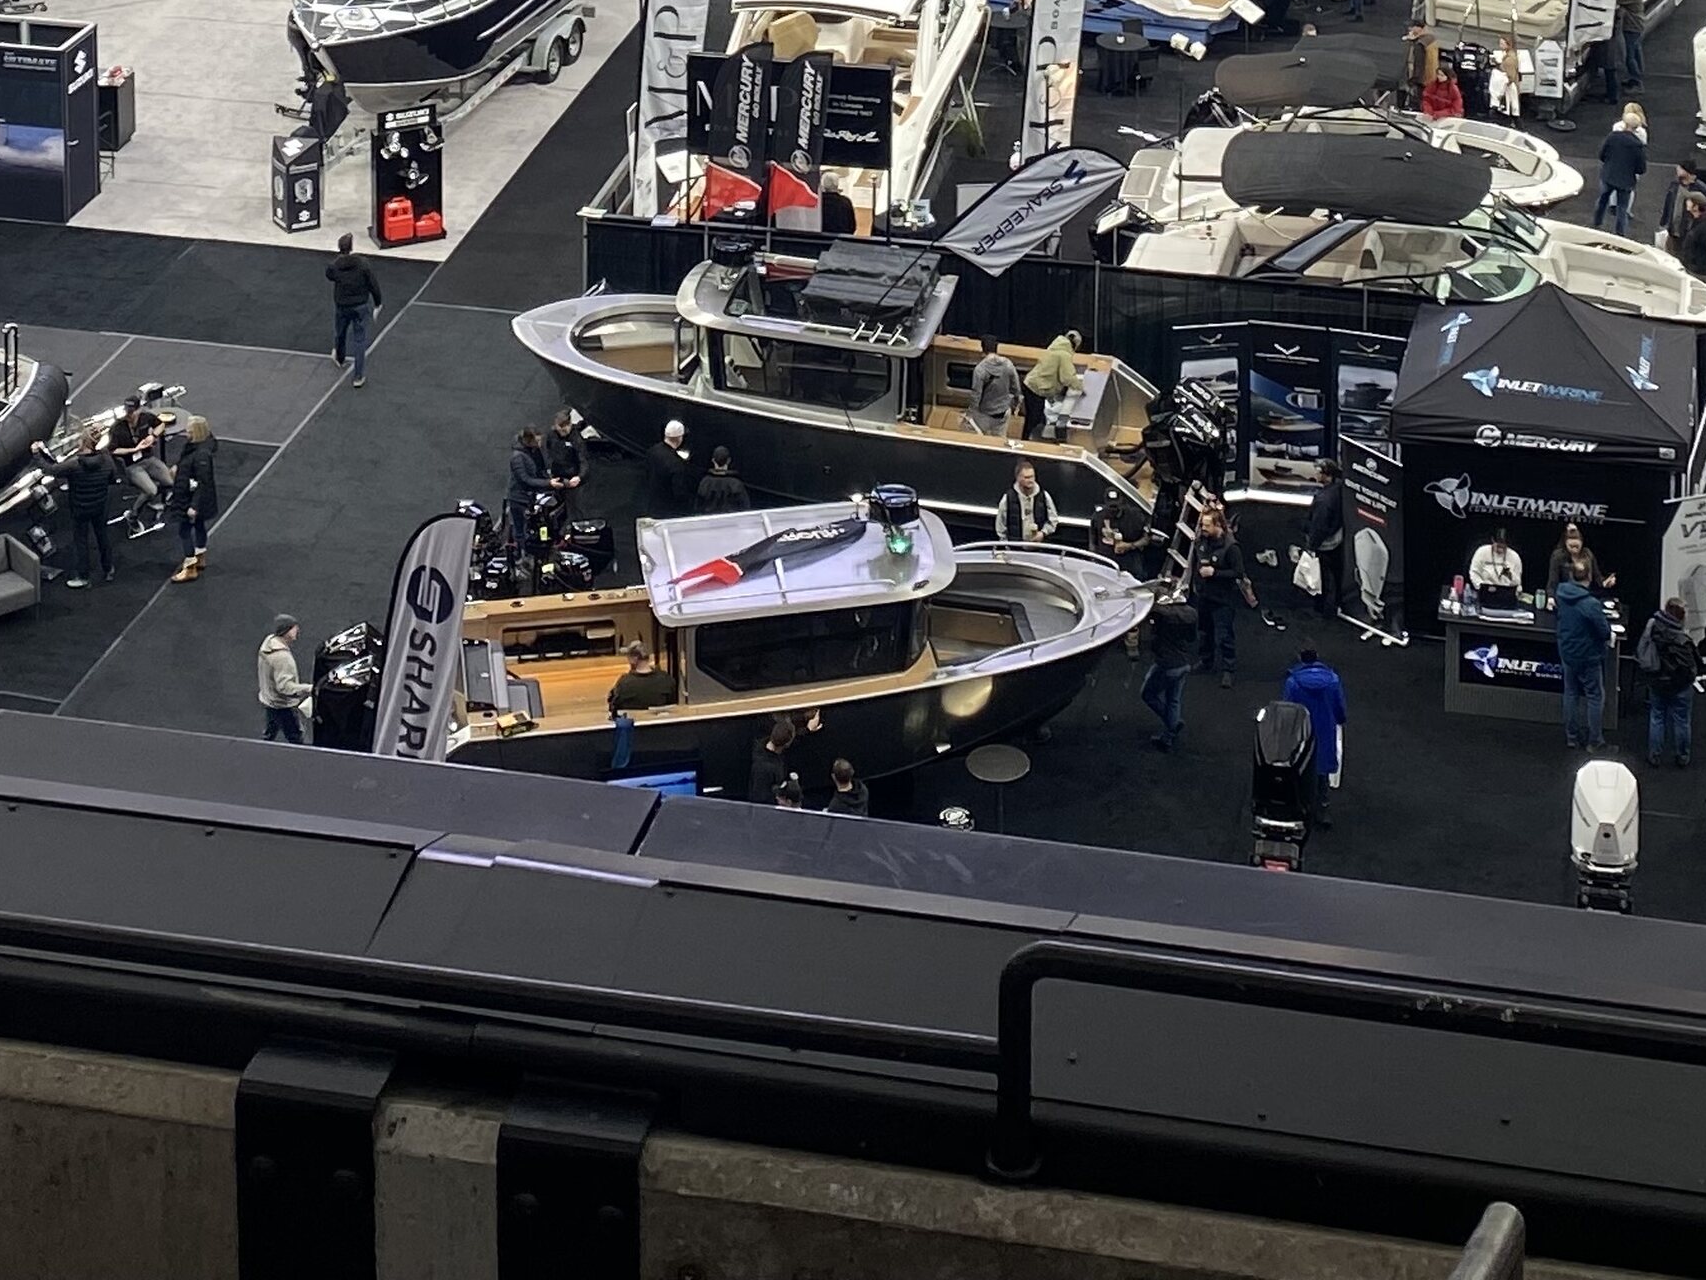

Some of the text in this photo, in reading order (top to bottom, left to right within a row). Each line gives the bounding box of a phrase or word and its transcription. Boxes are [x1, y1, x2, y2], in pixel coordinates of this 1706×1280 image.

[644, 5, 697, 130] M&P
[754, 65, 764, 103] BOLDLY
[736, 54, 757, 144] MERCURY
[797, 60, 817, 150] MERCURY
[969, 176, 1064, 259] SEAKEEPER
[1496, 377, 1605, 403] INLETMARINE
[1502, 432, 1598, 453] MERCURY
[1351, 462, 1390, 485] MERCURY
[1470, 490, 1609, 519] INLETMARINE
